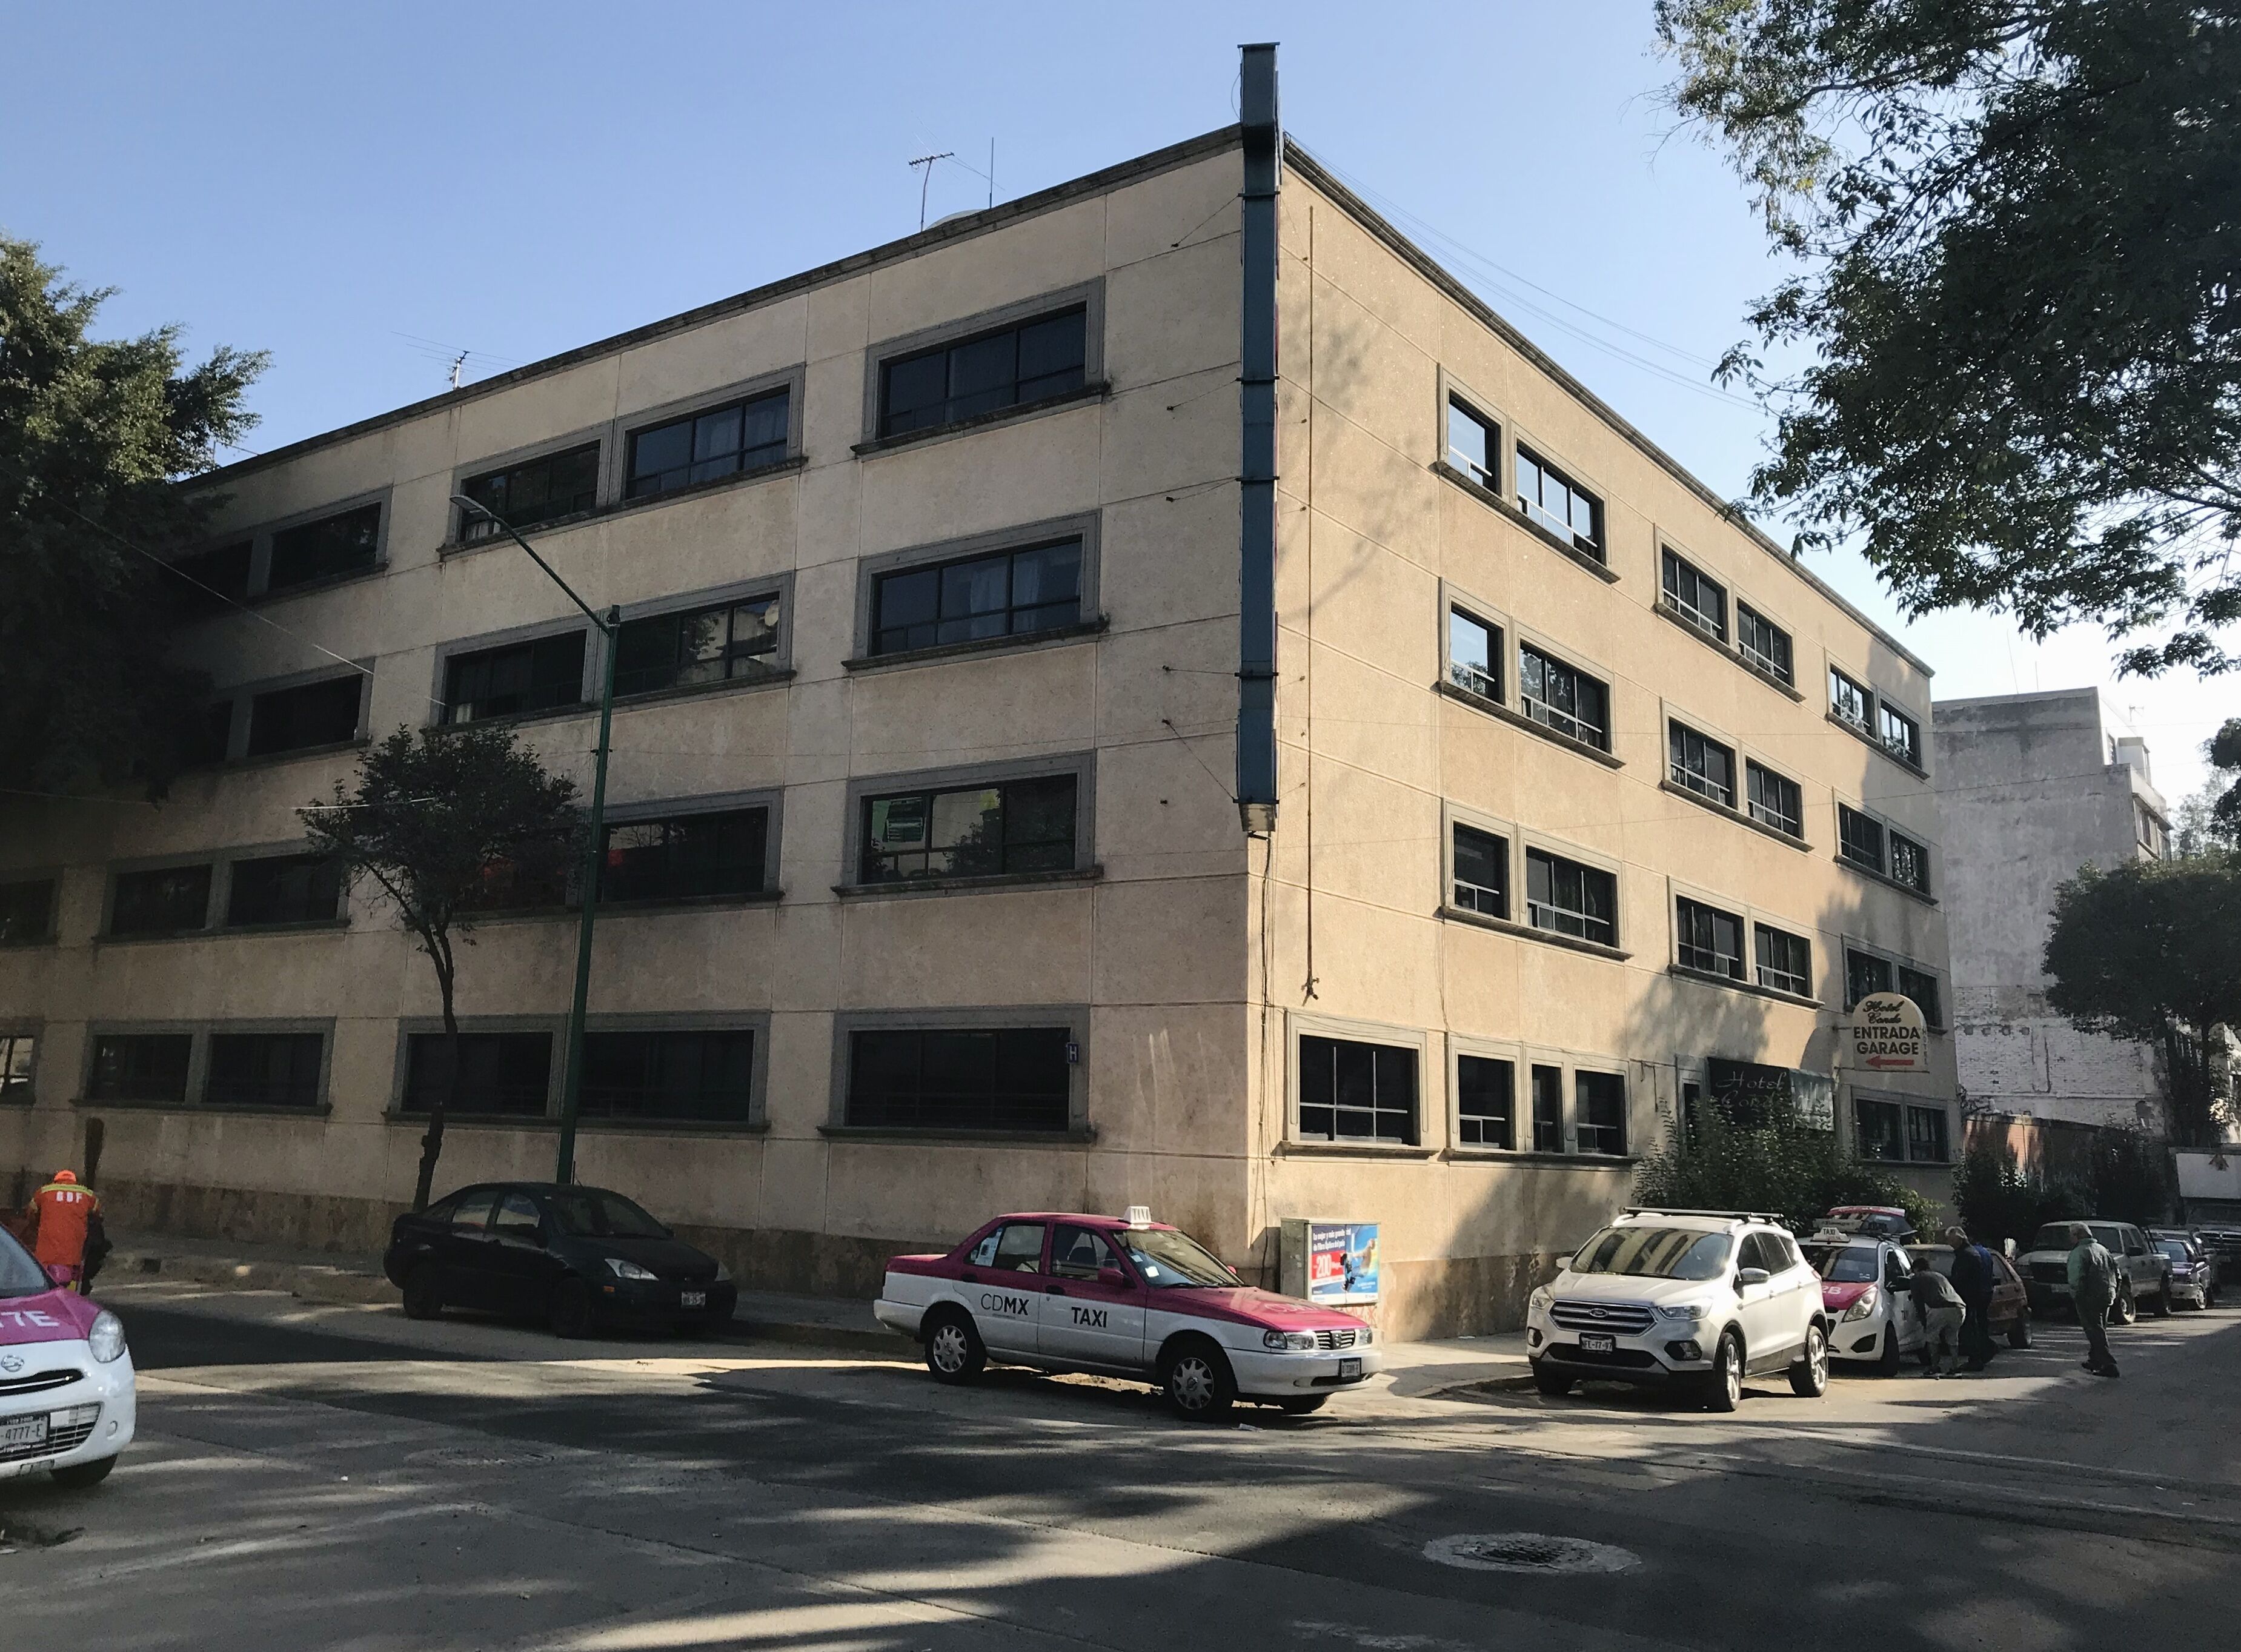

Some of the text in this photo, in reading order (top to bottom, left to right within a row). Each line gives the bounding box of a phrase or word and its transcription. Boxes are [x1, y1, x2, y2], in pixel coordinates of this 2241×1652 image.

[1863, 1000, 1905, 1012] Hotel
[1854, 1026, 1921, 1040] ENTRADA
[1070, 1046, 1077, 1060] H
[1857, 1041, 1919, 1055] GARAGE
[1716, 1071, 1787, 1091] Hotel
[1133, 1208, 1149, 1220] TAXI
[1316, 1254, 1332, 1278] 200
[1822, 1286, 1842, 1295] 2B
[980, 1293, 1029, 1315] CDMX
[0, 1311, 60, 1327] 7E
[1071, 1306, 1107, 1328] TAXI
